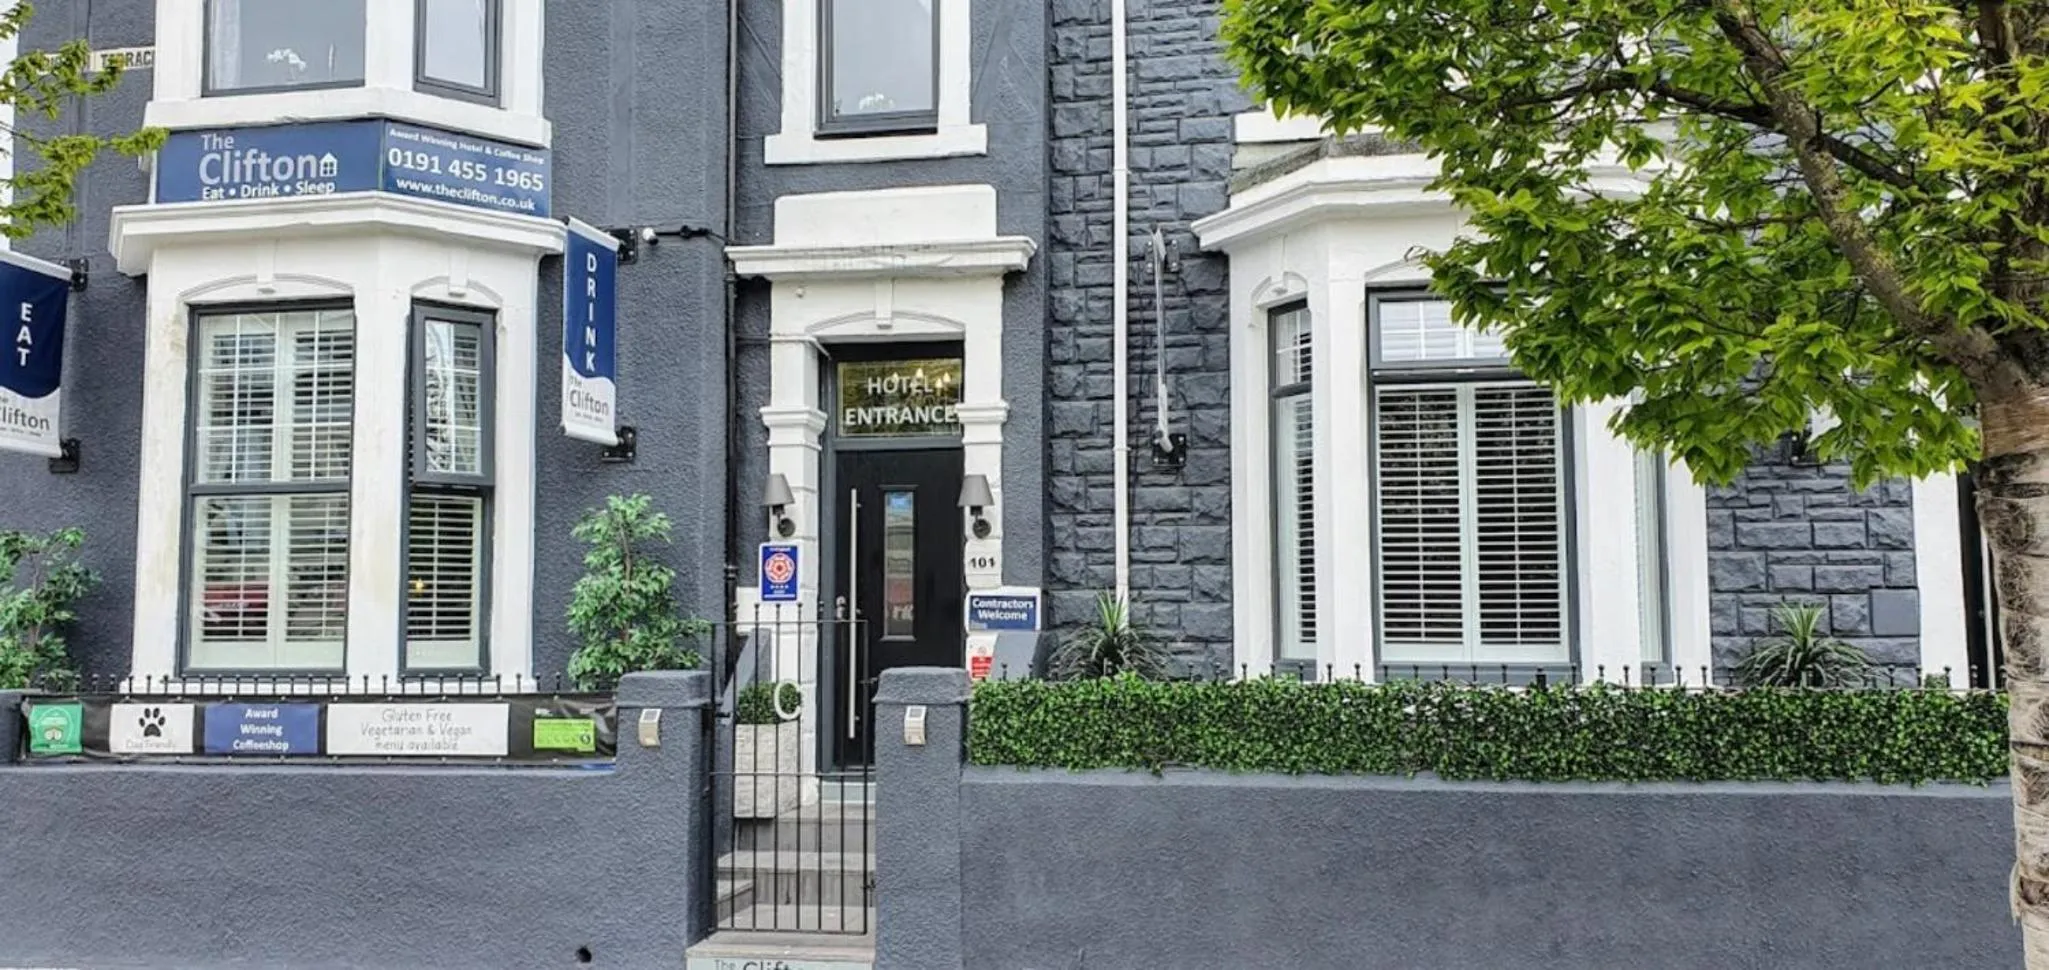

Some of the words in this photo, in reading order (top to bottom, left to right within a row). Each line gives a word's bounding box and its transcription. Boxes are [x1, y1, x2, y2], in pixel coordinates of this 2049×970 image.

[101, 51, 155, 67] TRRAC
[201, 134, 234, 150] The
[389, 128, 419, 141] Award
[421, 134, 458, 150] Winning
[459, 142, 482, 153] Hotel
[494, 147, 520, 161] Coffee
[522, 152, 544, 165] Shop
[199, 149, 317, 184] Clifton
[388, 147, 442, 175] 0191
[448, 159, 487, 182] 455
[494, 167, 544, 192] 1965
[203, 186, 225, 200] Eat
[240, 182, 280, 197] Drink
[296, 180, 336, 195] Sleep
[396, 177, 535, 211] www.theclifton.co.uk
[586, 252, 598, 372] DRINK
[16, 302, 33, 367] EAT
[867, 375, 934, 394] HOTEL
[569, 389, 610, 417] Clifton
[0, 405, 50, 431] lifton
[845, 405, 957, 426] ENTRANCE
[970, 557, 996, 569] 101
[972, 598, 1034, 609] Contractors
[977, 609, 1028, 621] Welcome
[245, 707, 279, 719] Award
[381, 708, 422, 722] Gluten
[426, 708, 452, 722] Free
[240, 724, 283, 737] Winning
[361, 723, 423, 740] Vegetarian
[427, 724, 435, 736] &
[440, 723, 472, 740] Vegan
[233, 739, 289, 752] Coffeeshop
[408, 738, 459, 751] available
